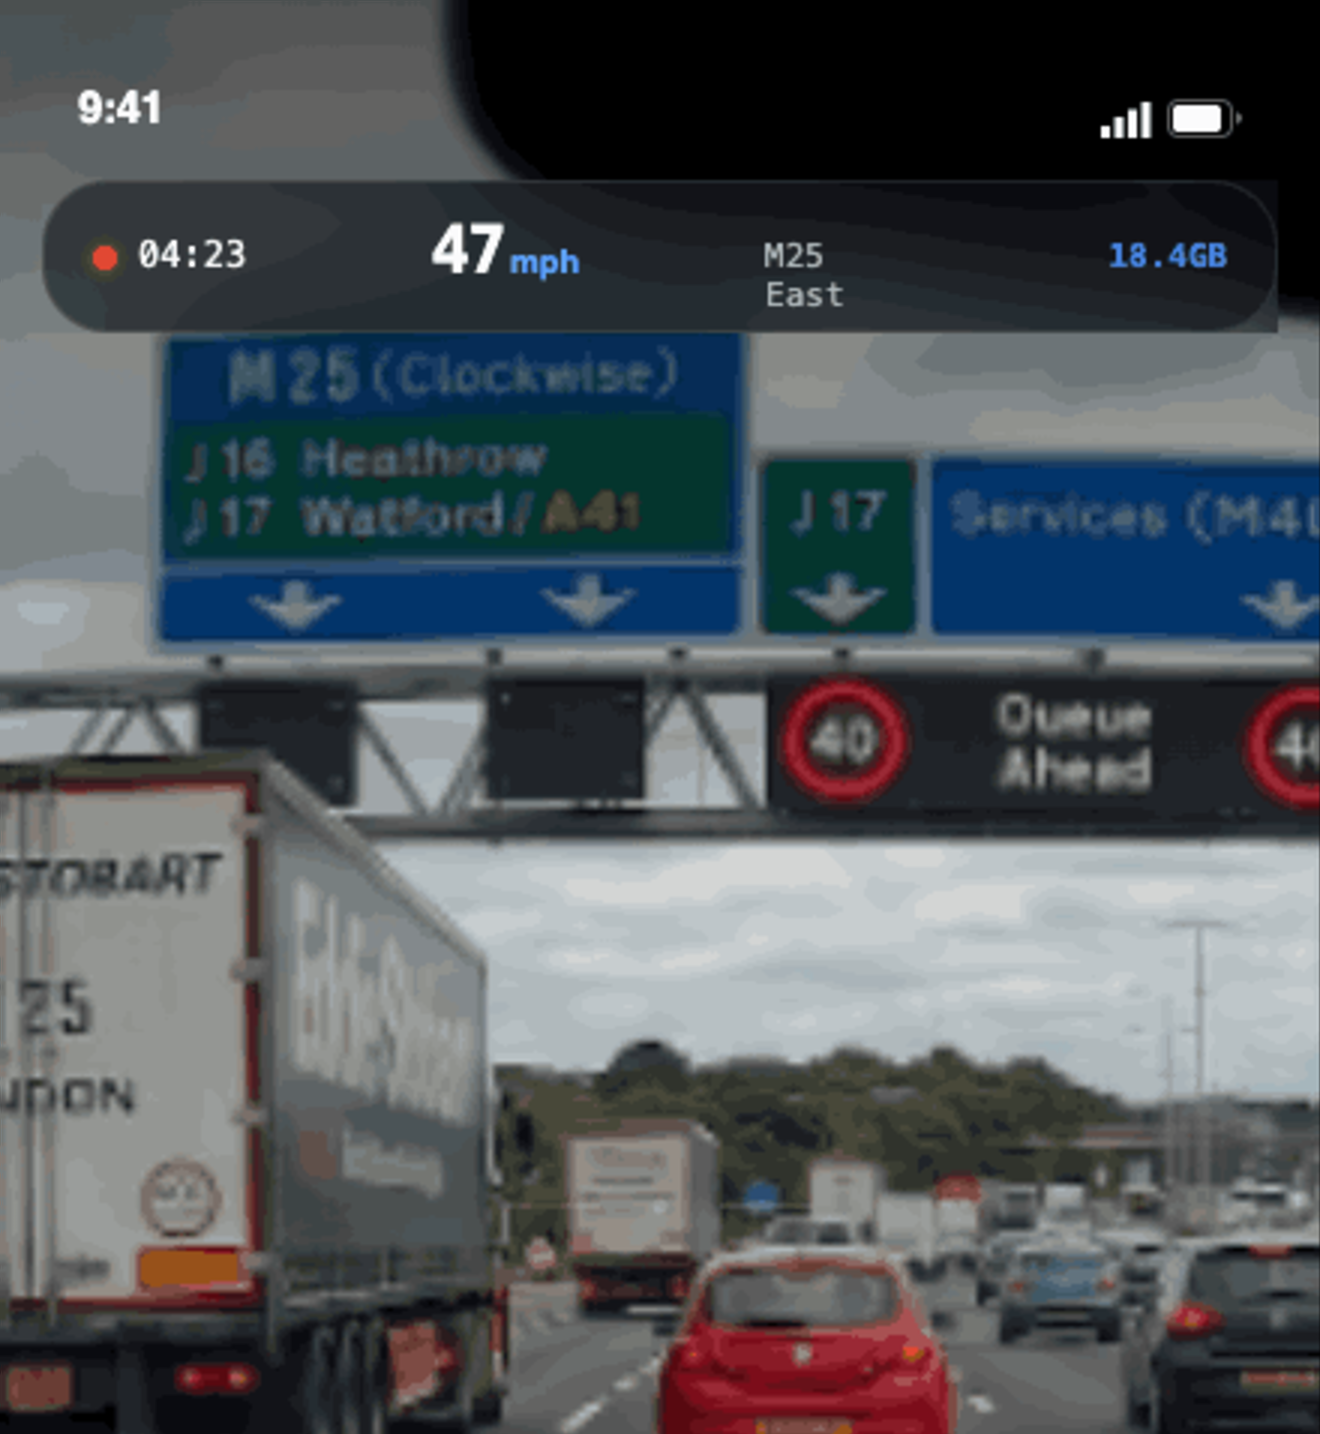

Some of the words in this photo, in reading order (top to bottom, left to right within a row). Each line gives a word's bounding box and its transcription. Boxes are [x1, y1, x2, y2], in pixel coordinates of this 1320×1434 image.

[372, 346, 678, 401] (Clockwise)
[302, 437, 548, 478] Heathrow
[950, 488, 1169, 539] Services
[808, 714, 880, 766] 40
[998, 746, 1152, 791] Ahead
